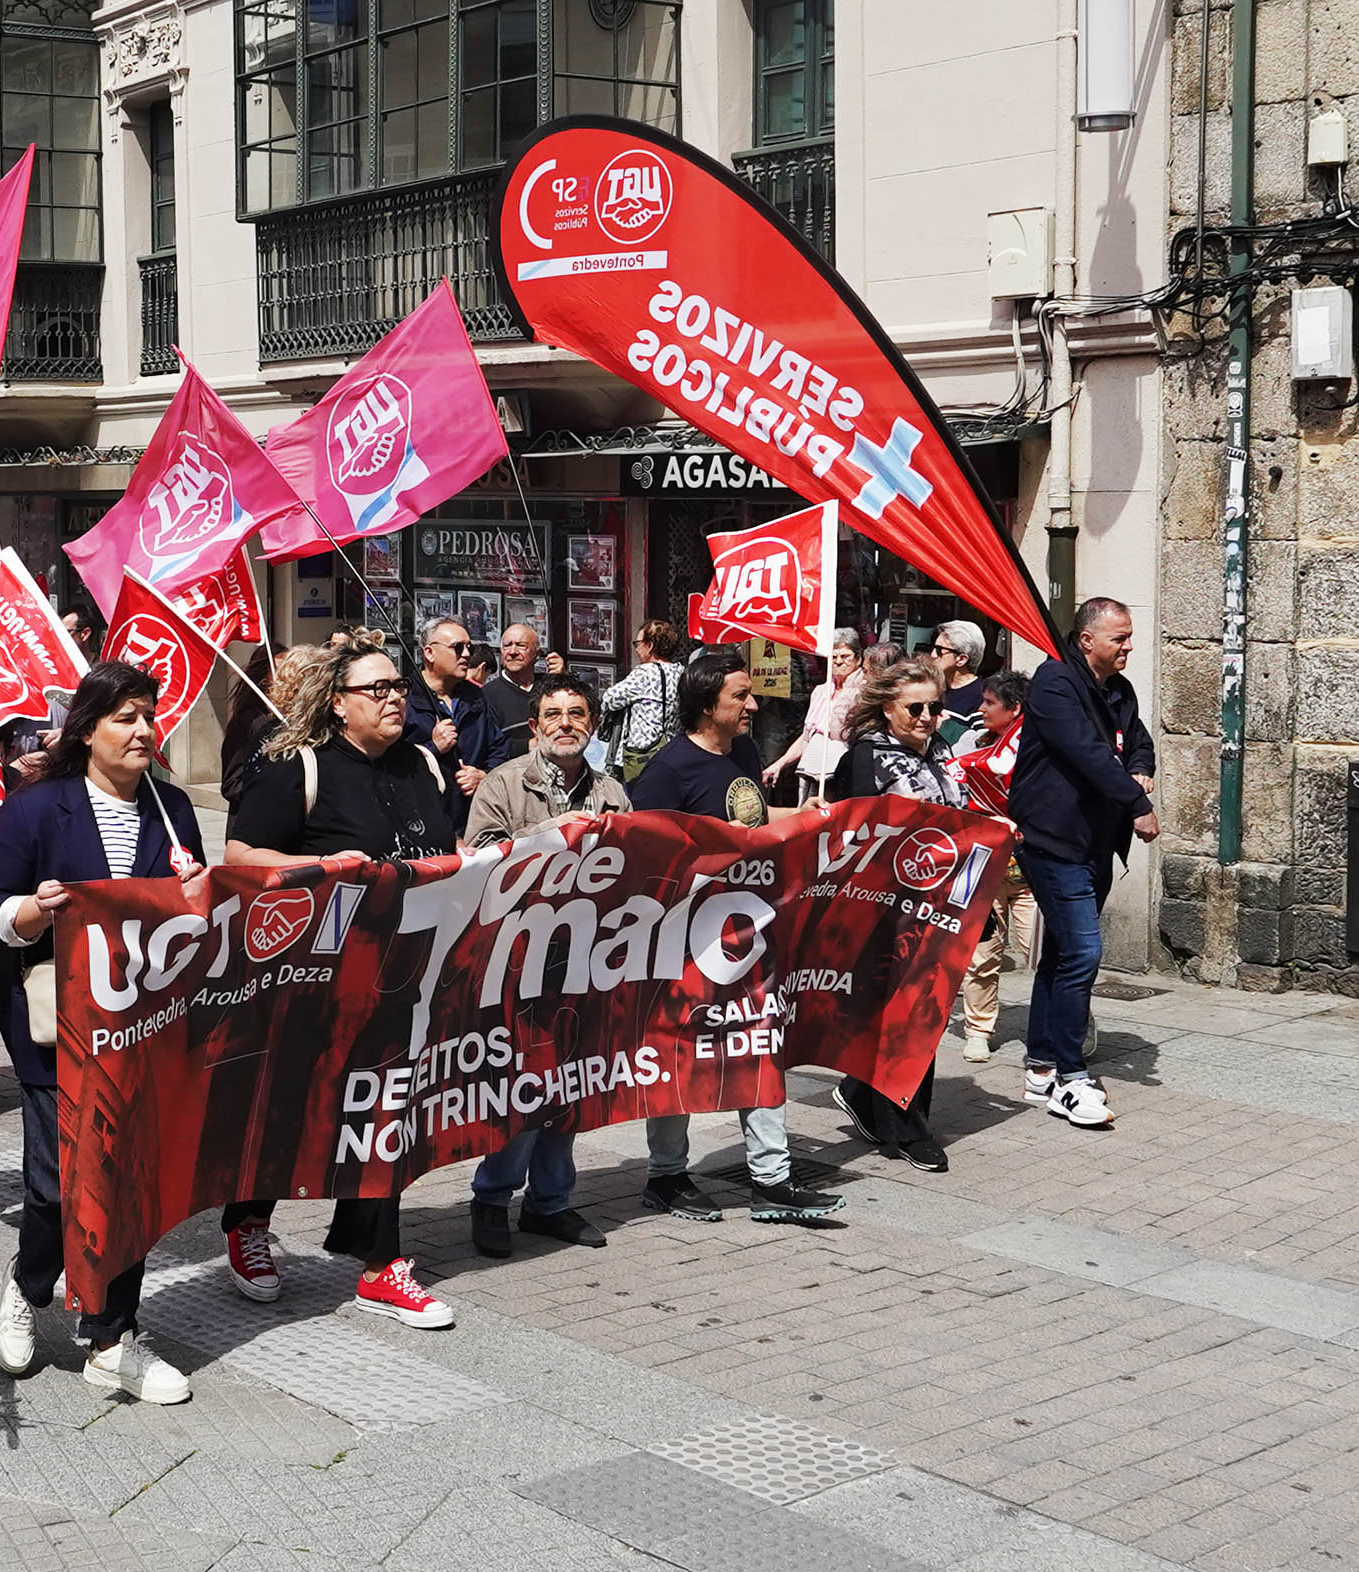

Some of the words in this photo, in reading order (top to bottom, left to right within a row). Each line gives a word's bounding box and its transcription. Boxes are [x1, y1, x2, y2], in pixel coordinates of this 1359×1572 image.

[439, 530, 537, 557] PEDROSA
[716, 552, 788, 612] UGT
[540, 834, 625, 895] de
[841, 882, 897, 905] Arousa
[901, 900, 913, 914] e
[916, 902, 962, 934] Deza
[86, 895, 241, 1012] UGT
[480, 875, 776, 1008] maio
[191, 978, 257, 1007] Arousa
[261, 975, 271, 990] e
[277, 964, 333, 985] Deza
[696, 1034, 715, 1059] E
[335, 1105, 418, 1164] NON
[422, 1046, 671, 1137] TRINCHEIRAS.
